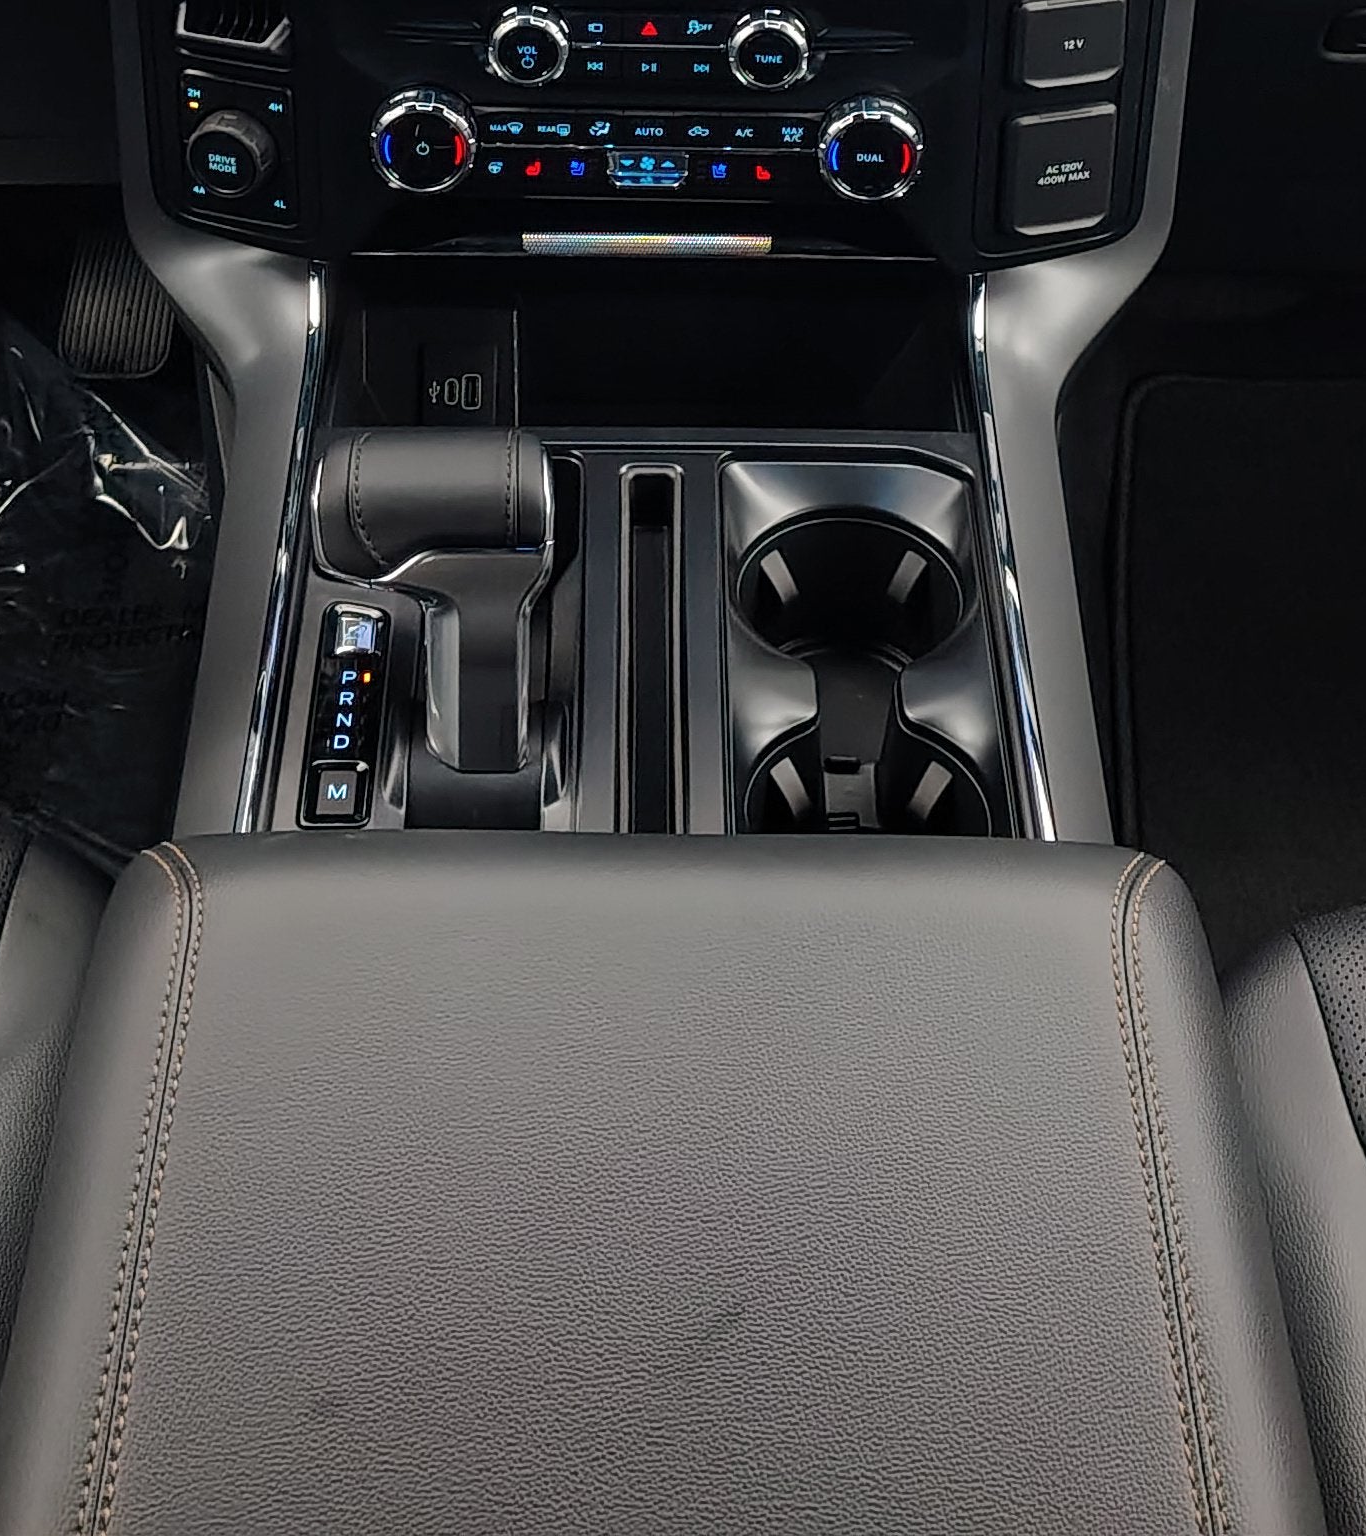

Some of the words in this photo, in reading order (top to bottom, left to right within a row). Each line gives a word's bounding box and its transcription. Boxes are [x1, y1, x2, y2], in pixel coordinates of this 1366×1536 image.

[517, 46, 538, 55] VOL
[755, 54, 783, 64] TUNE
[187, 88, 201, 99] 2H
[268, 102, 283, 113] 4H
[490, 124, 508, 132] MAX
[537, 125, 556, 133] REAR
[635, 127, 664, 137] AUTO
[735, 128, 754, 138] A/C
[782, 127, 804, 136] MAX
[784, 134, 802, 143] A/C
[208, 153, 237, 165] DRIVE
[856, 153, 885, 163] DUAL
[208, 163, 237, 175] MODE
[1046, 165, 1060, 175] AC
[1061, 161, 1084, 173] 120V
[1037, 174, 1066, 186] 400W
[1068, 171, 1090, 182] MAX
[192, 185, 206, 195] 4A
[273, 199, 287, 209] 4L
[342, 671, 357, 685] P
[339, 692, 354, 706] R
[336, 713, 352, 727] N
[333, 735, 350, 750] D
[327, 783, 348, 800] M
